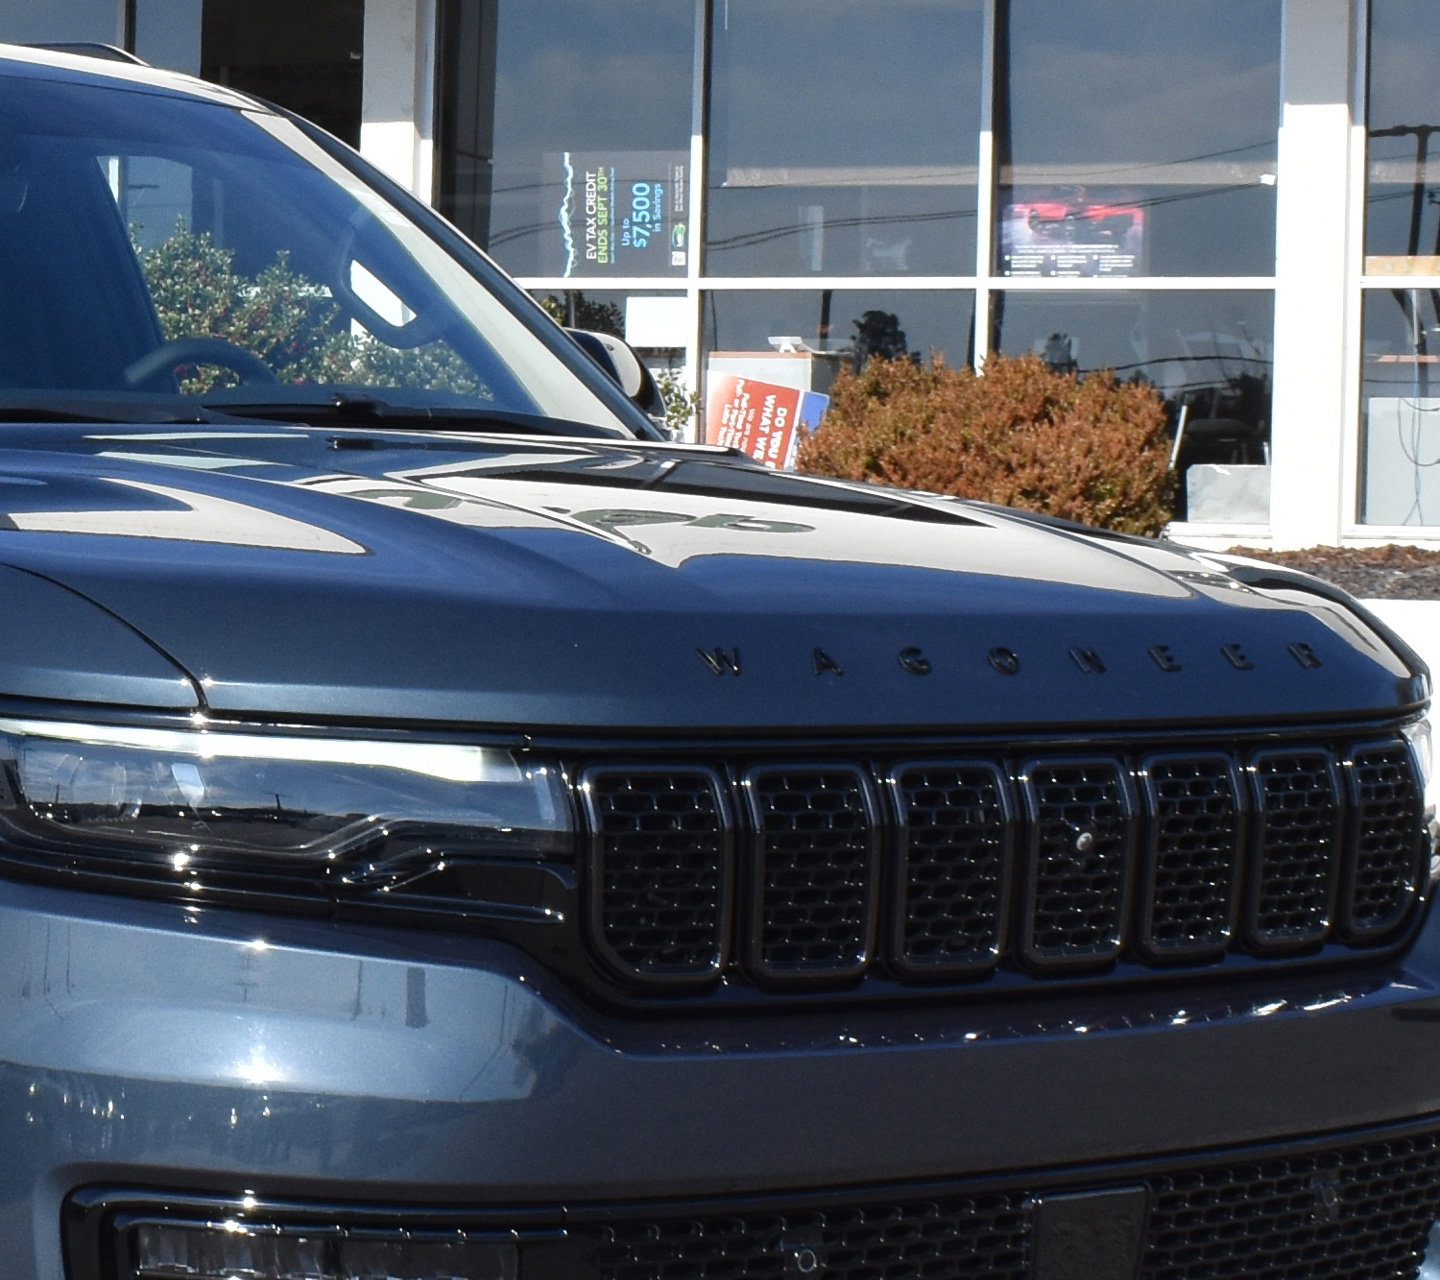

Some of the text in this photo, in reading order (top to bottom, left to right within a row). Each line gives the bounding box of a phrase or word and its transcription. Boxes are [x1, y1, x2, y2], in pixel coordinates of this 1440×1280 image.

[586, 171, 597, 260] EV TAX CREDIT
[597, 195, 609, 226] SEPT
[632, 182, 652, 248] $7,500
[653, 183, 664, 233] in Savings
[597, 229, 609, 264] ENDS
[621, 218, 632, 247] Up to
[759, 394, 777, 434] WHAT
[774, 407, 788, 427] DO
[768, 431, 783, 458] YOU
[695, 642, 1323, 677] WAGONEER
